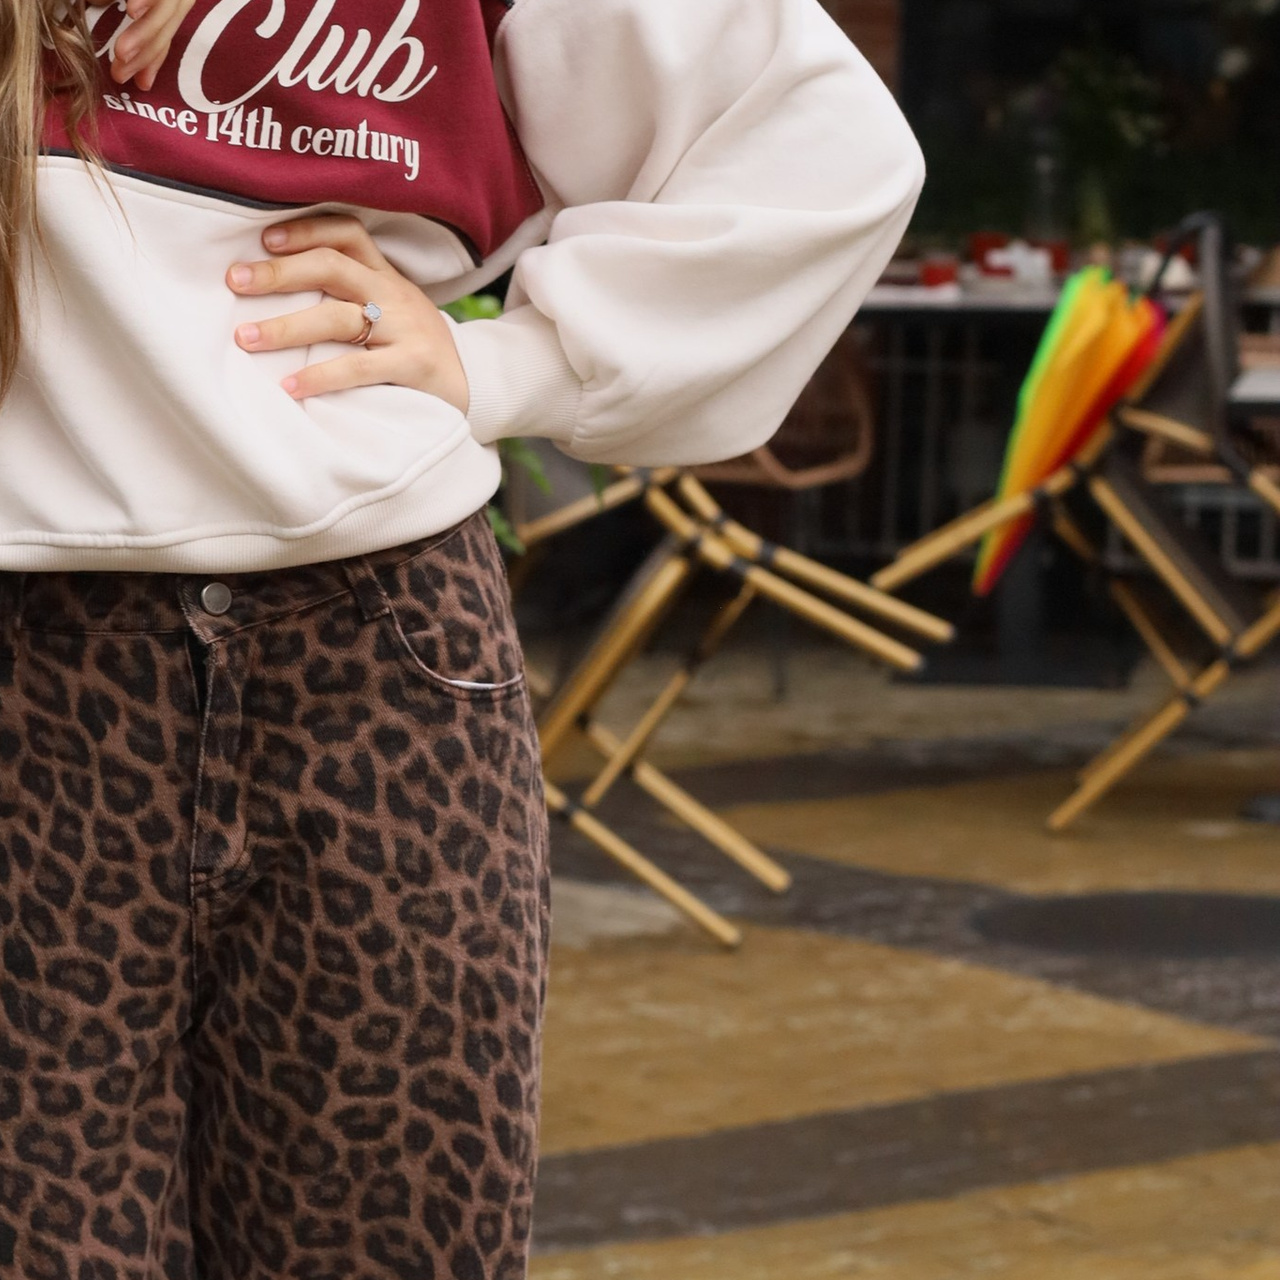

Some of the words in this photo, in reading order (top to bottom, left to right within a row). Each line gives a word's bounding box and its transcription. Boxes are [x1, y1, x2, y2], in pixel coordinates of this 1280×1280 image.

[103, 91, 199, 137] since
[206, 102, 282, 151] 14th
[290, 119, 420, 181] century
